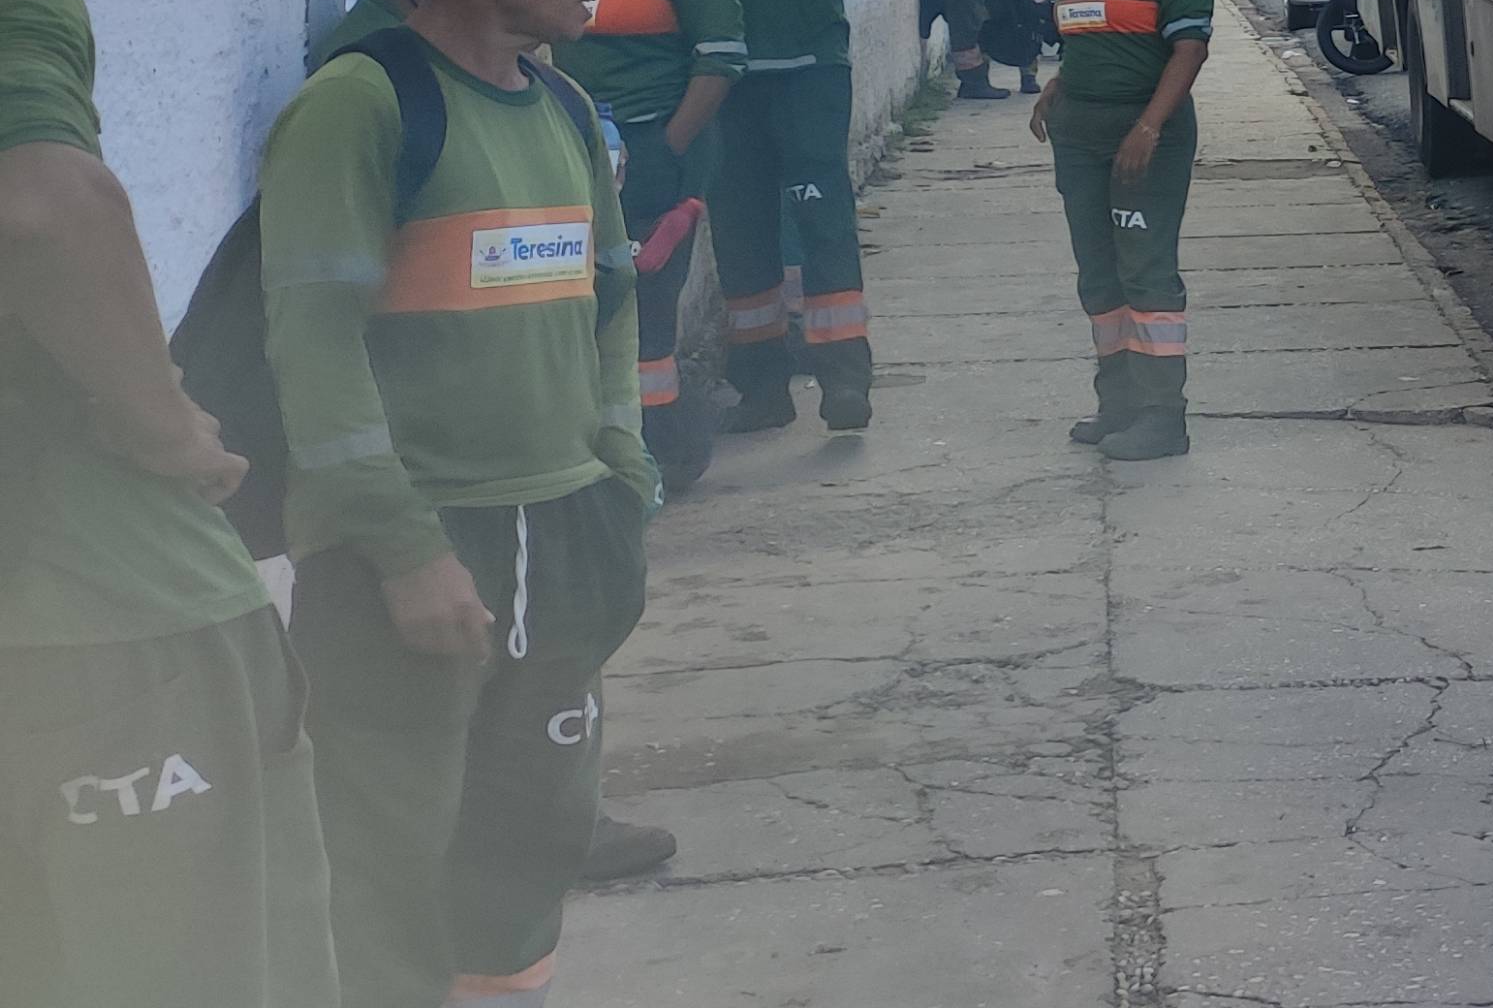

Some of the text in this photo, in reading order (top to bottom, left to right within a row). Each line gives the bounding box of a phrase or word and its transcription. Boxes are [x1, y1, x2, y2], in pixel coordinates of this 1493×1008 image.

[785, 183, 822, 201] TA
[510, 235, 583, 260] Teresina
[58, 753, 213, 824] CTA
